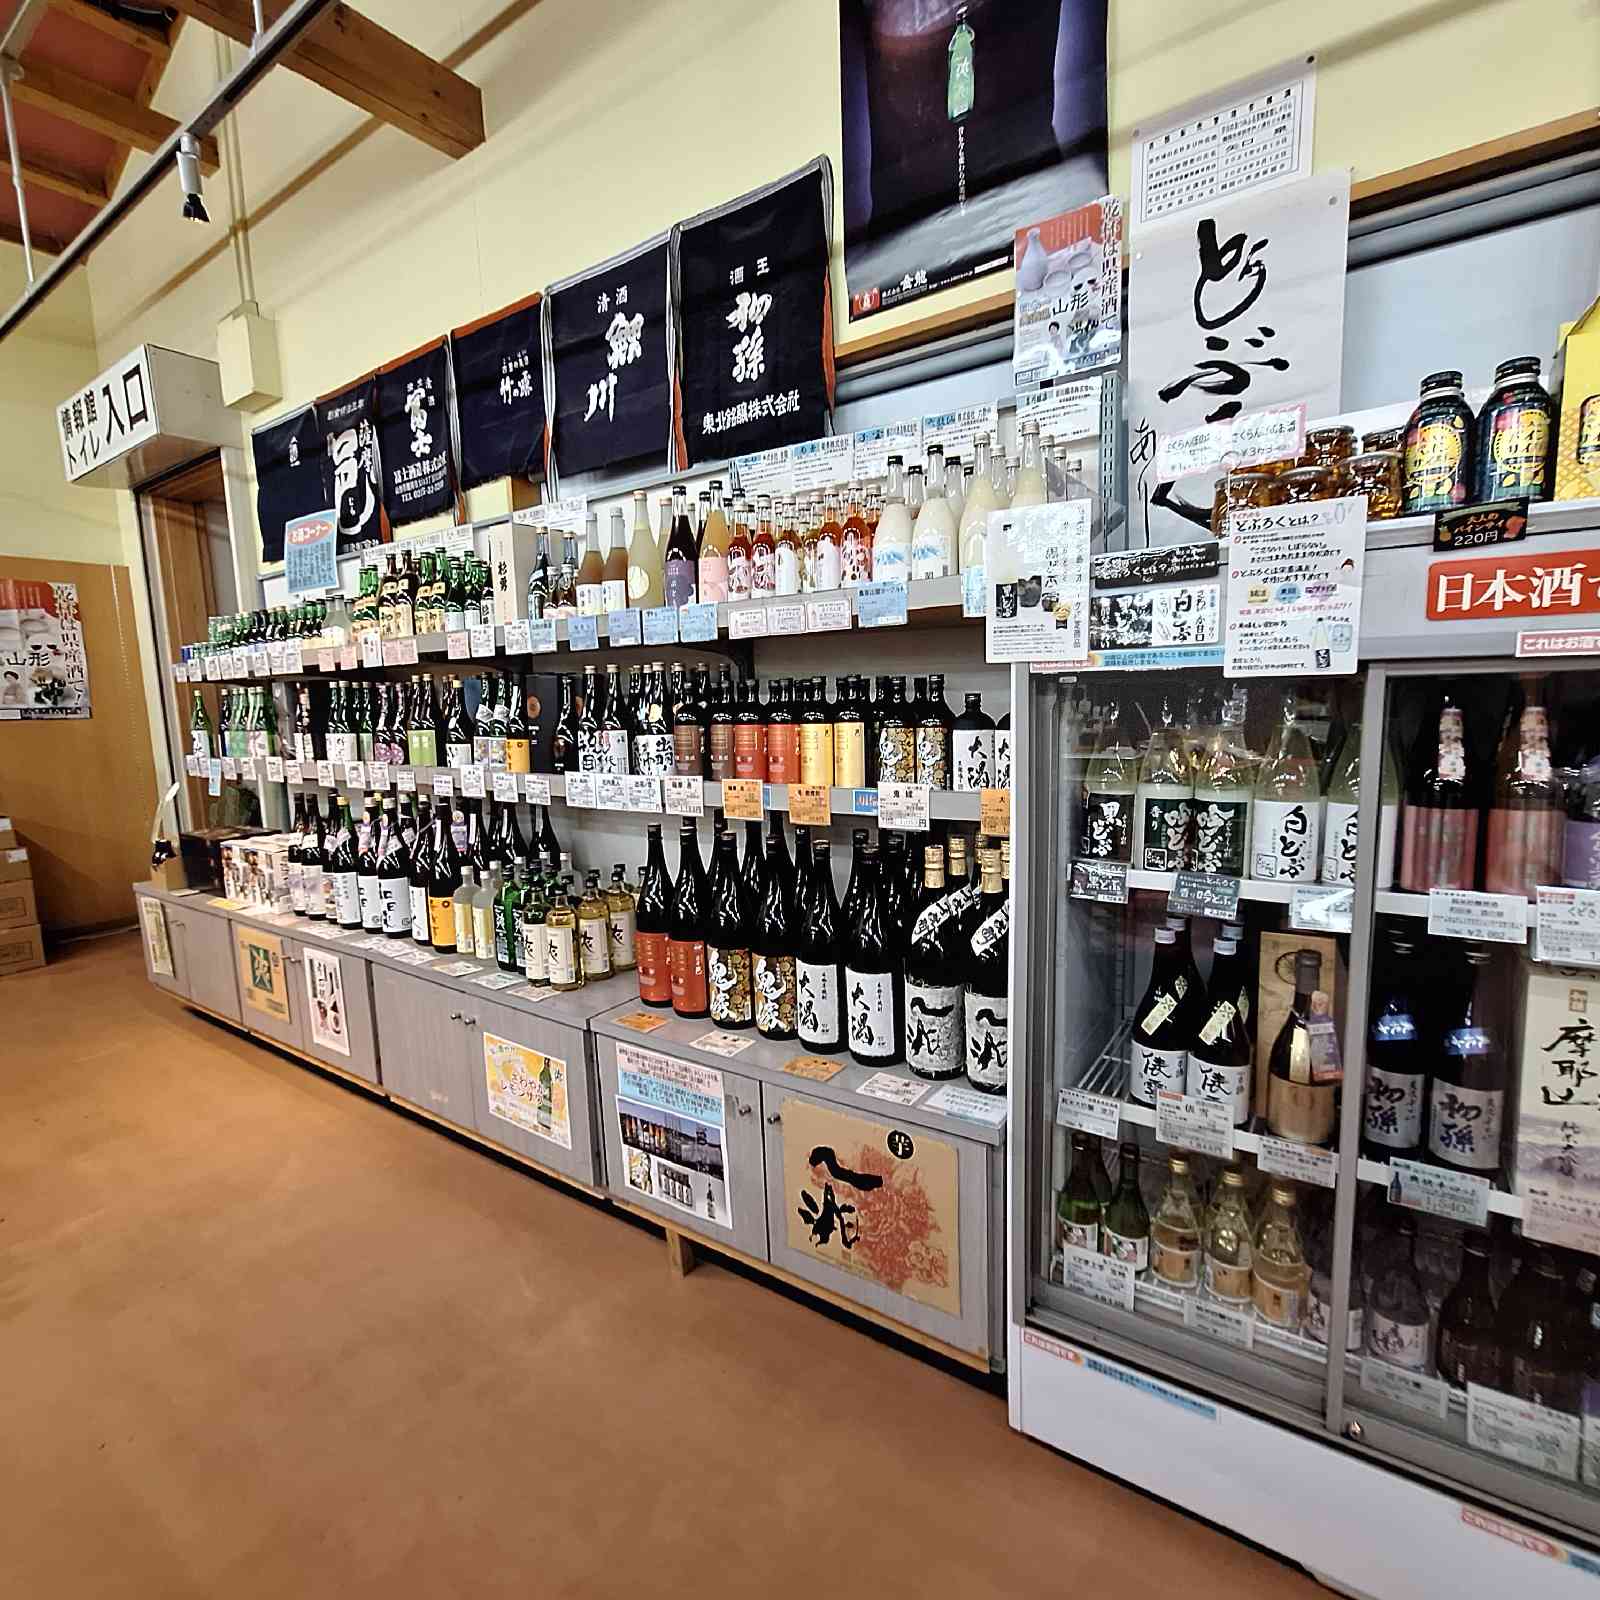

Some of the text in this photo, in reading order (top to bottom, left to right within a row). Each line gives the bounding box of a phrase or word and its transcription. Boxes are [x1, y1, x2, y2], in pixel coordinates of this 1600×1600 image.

[597, 285, 628, 313] 清酒
[1053, 290, 1089, 316] 山形
[102, 363, 148, 444] 入口
[702, 389, 800, 435] 東北銘醸株式会社
[66, 430, 100, 475] トイレ
[1454, 530, 1498, 546] 220円
[6, 651, 51, 667] 山形
[1279, 804, 1306, 879] 白どぶ
